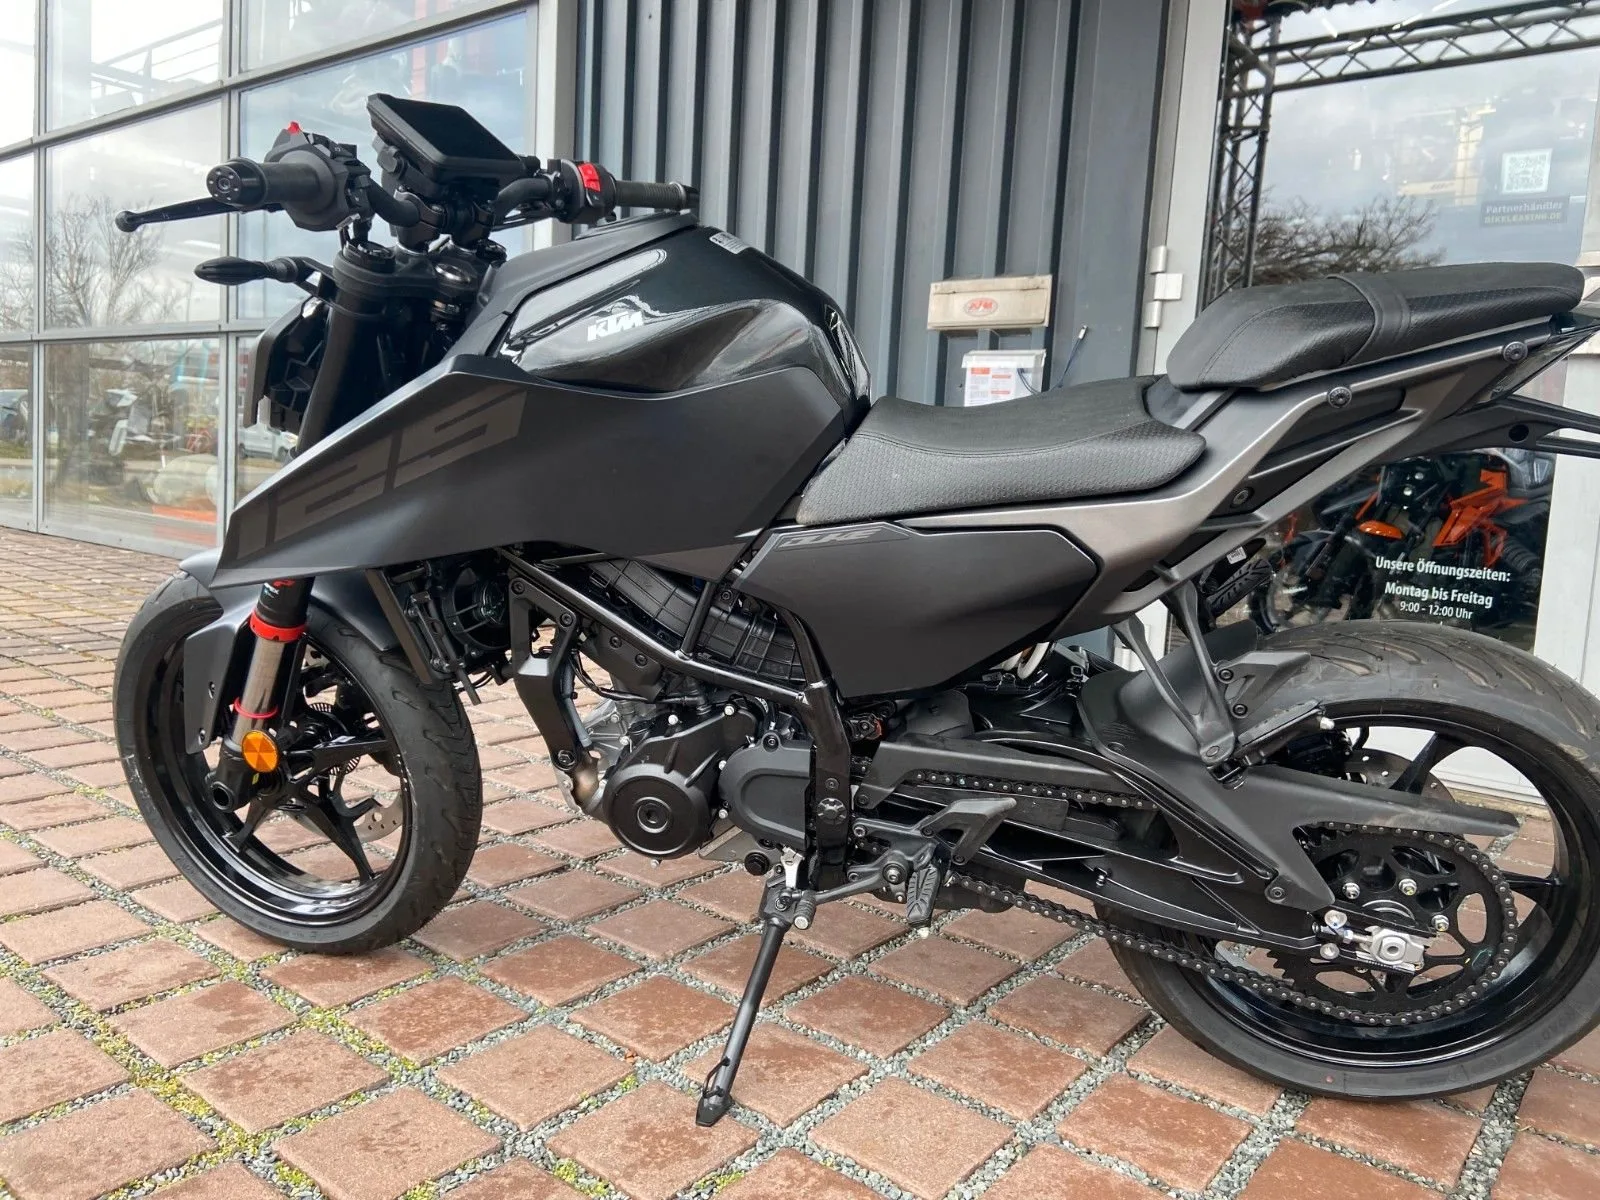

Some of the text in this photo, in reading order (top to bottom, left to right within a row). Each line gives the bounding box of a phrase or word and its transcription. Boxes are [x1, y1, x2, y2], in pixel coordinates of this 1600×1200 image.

[587, 310, 643, 341] KTM
[1375, 556, 1512, 582] Unsere Öffnungszeiten:
[1384, 581, 1494, 608] Montag bis Freitag
[1400, 600, 1420, 613] 9:00
[1428, 604, 1454, 617] 12:00
[1455, 607, 1473, 620] Uhr
